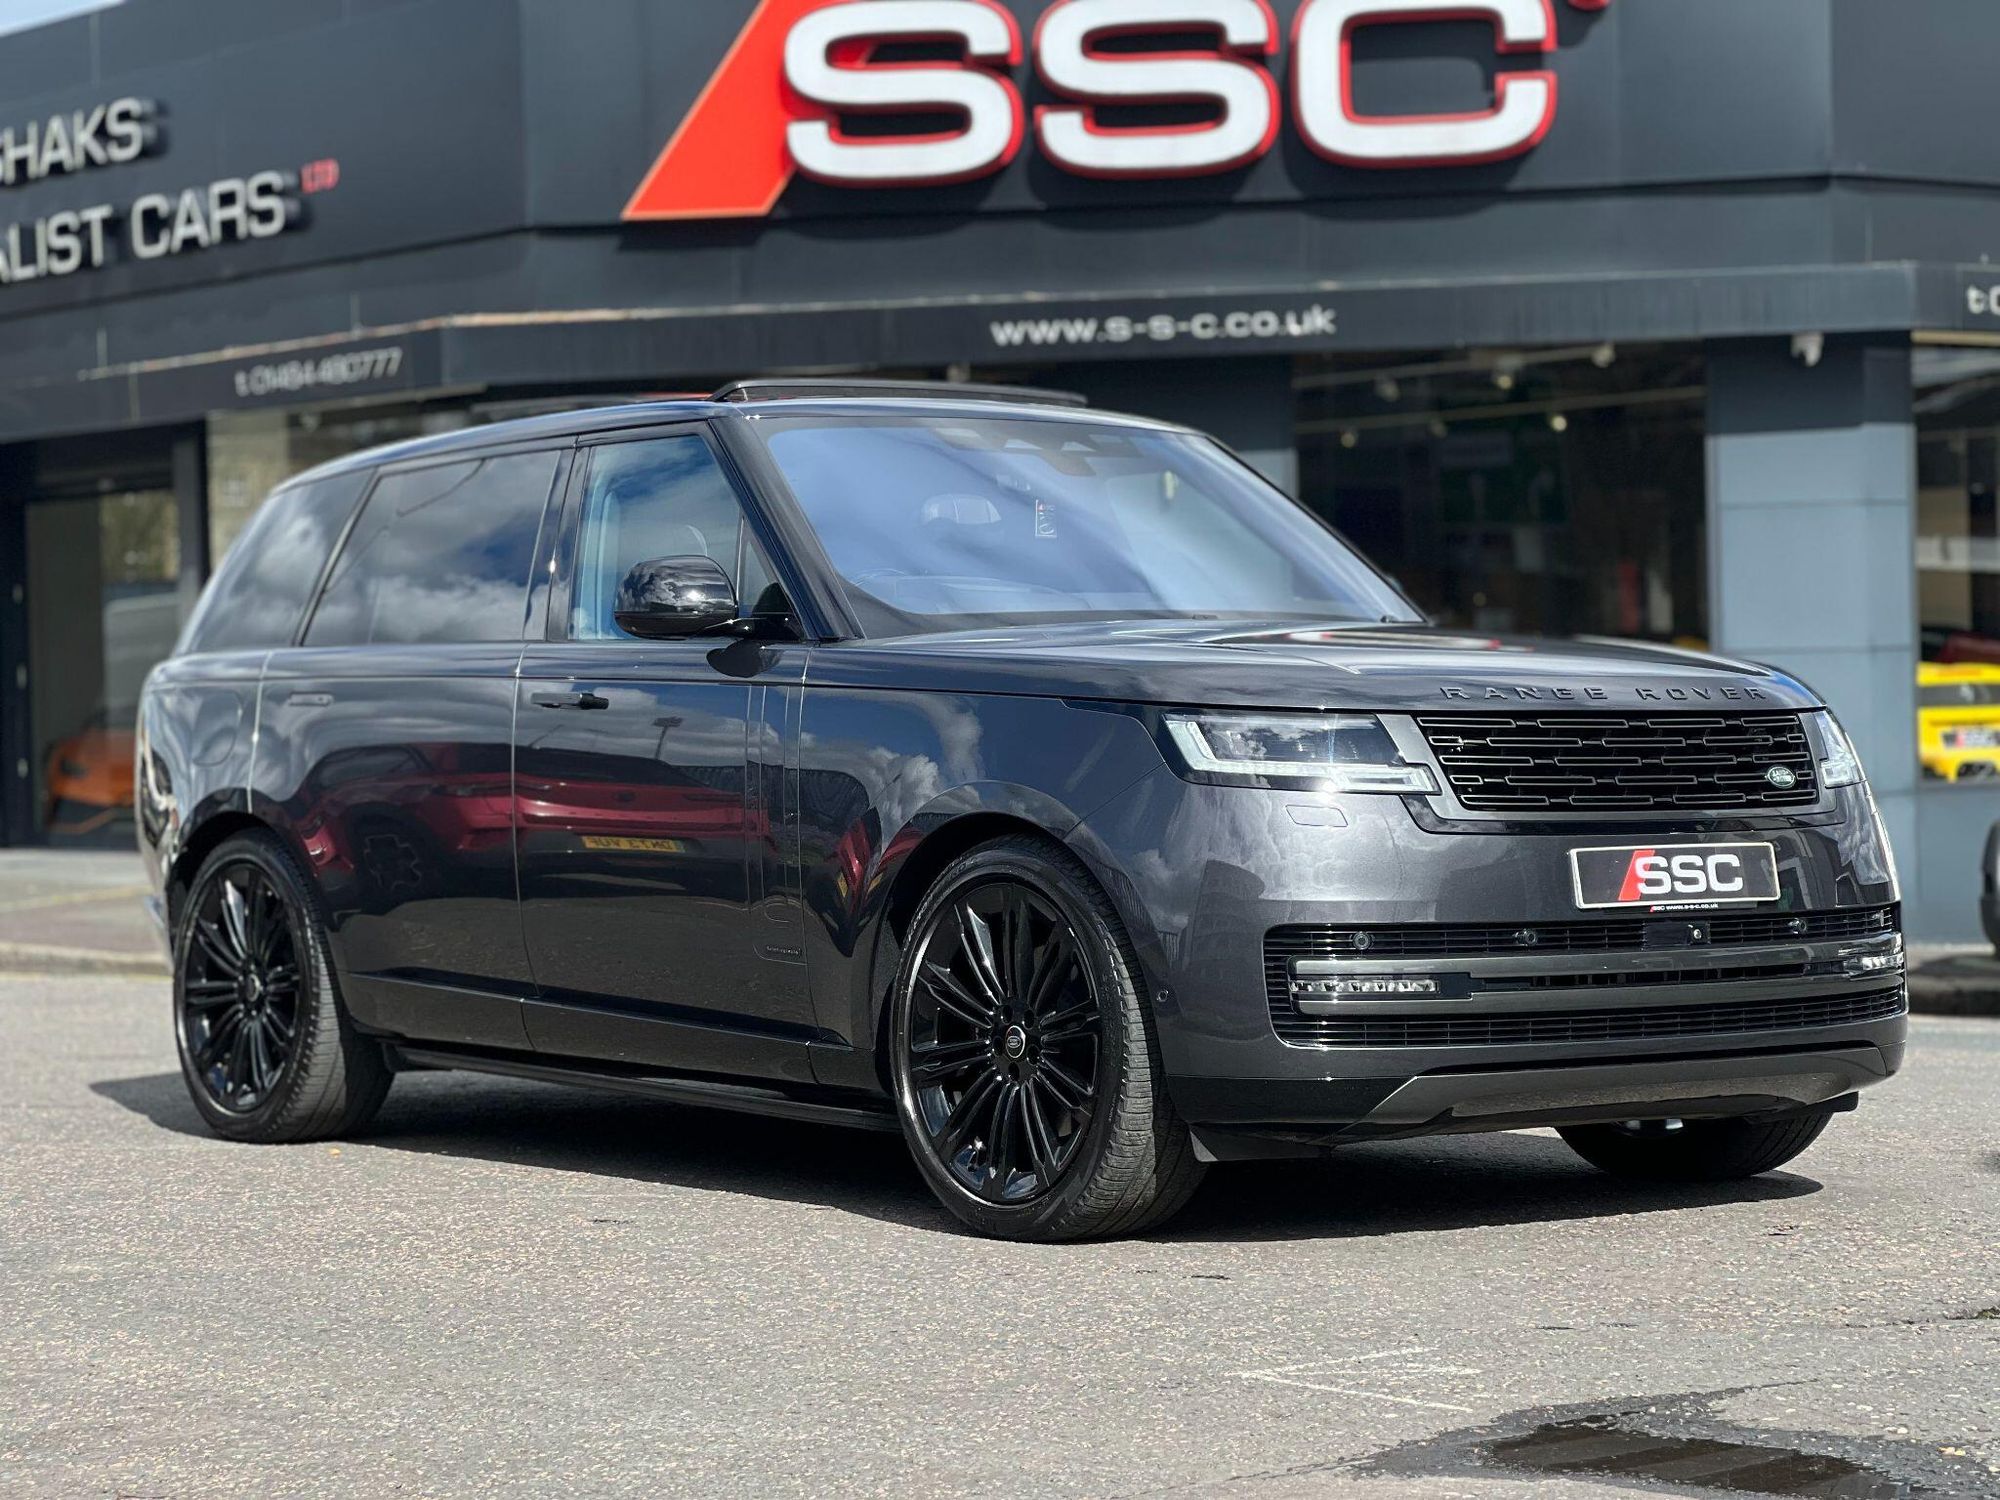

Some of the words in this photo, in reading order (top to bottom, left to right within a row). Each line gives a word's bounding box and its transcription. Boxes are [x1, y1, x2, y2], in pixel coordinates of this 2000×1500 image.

[784, 0, 1558, 187] SSC
[0, 97, 144, 184] HAKS
[131, 171, 285, 259] CARS
[990, 303, 1337, 346] www.s-s-c.co.uk
[1439, 686, 1608, 701] RANGE
[1635, 687, 1767, 700] ROVER
[1634, 853, 1744, 895] SSC
